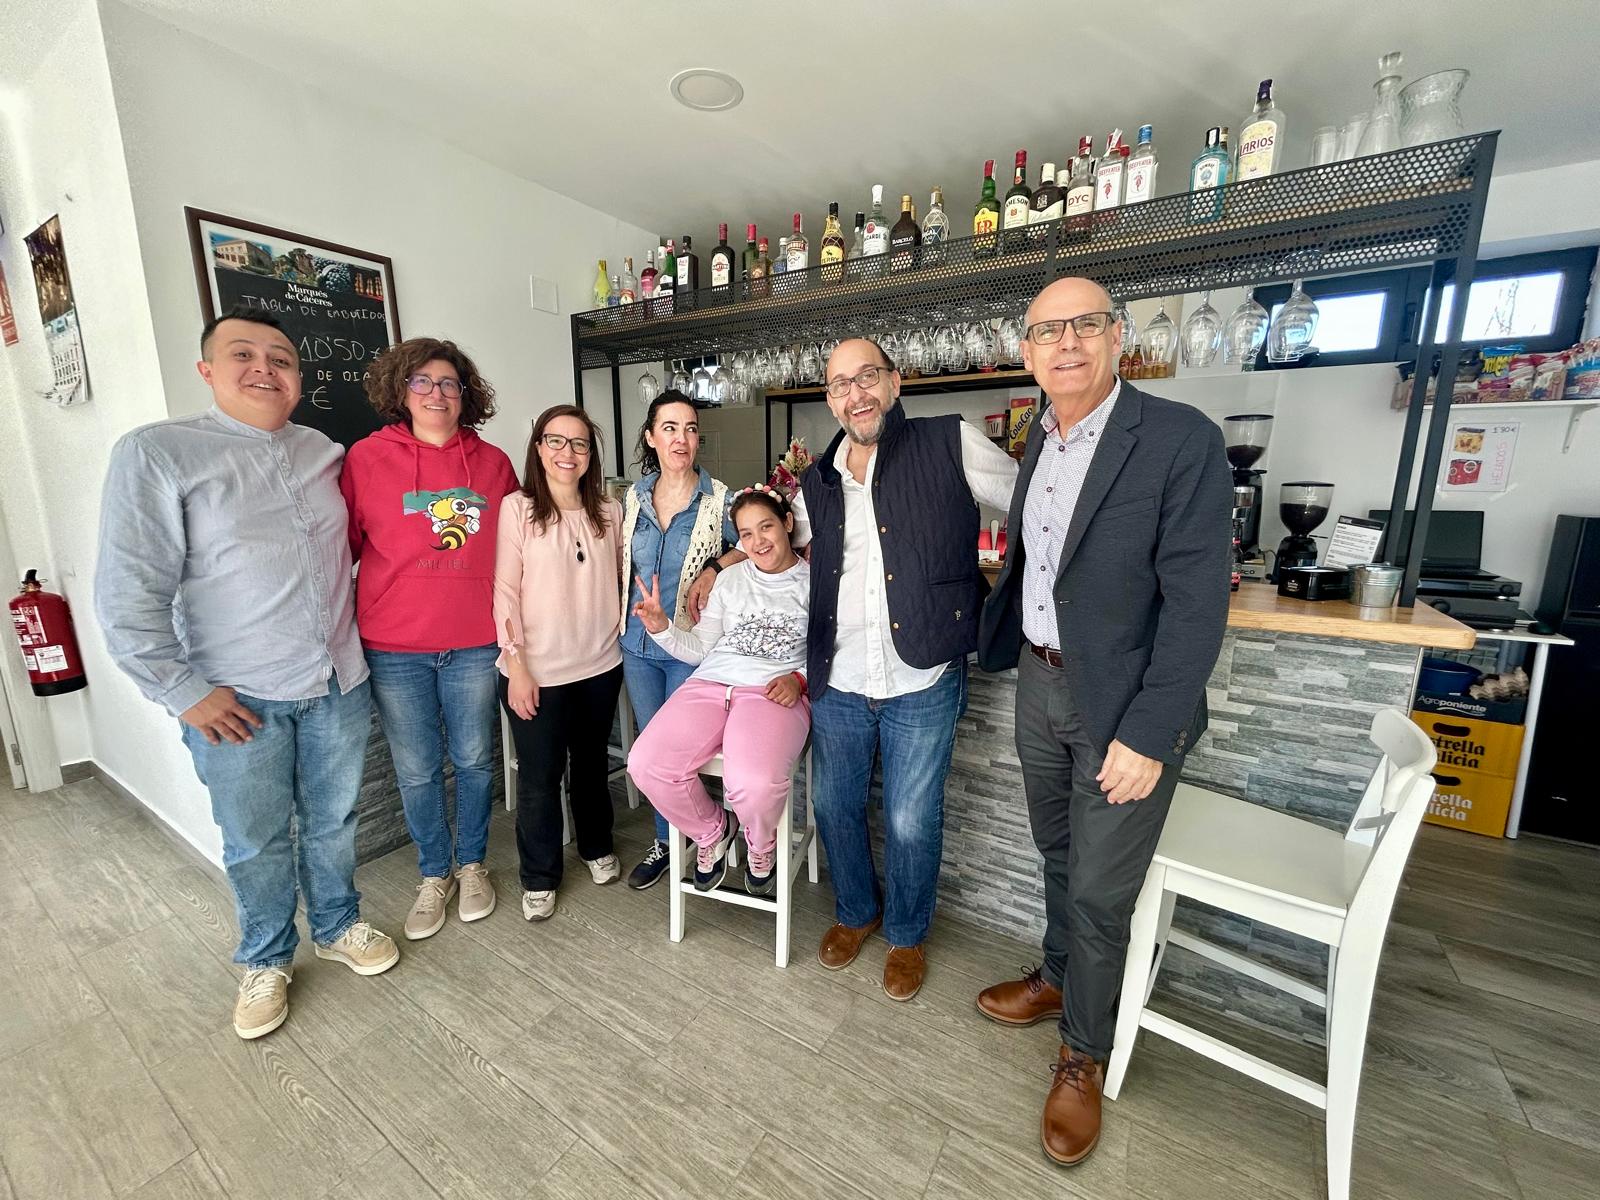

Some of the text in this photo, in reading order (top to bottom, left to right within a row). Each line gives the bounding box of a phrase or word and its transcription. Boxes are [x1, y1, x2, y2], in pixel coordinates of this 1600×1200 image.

[1240, 136, 1274, 156] LARIOS
[1098, 165, 1121, 176] BEEFEATER
[1128, 158, 1152, 170] BEEFEATER
[1068, 194, 1089, 206] DYC
[287, 282, 329, 299] Marqués
[241, 294, 293, 313] TABLA
[300, 305, 317, 316] DE
[284, 292, 333, 308] de Cáceres
[317, 370, 333, 380] DE
[1010, 407, 1032, 439] ColaCao
[1417, 695, 1488, 713] Agroponiente
[1436, 751, 1479, 768] licia
[1428, 802, 1467, 821] licia
